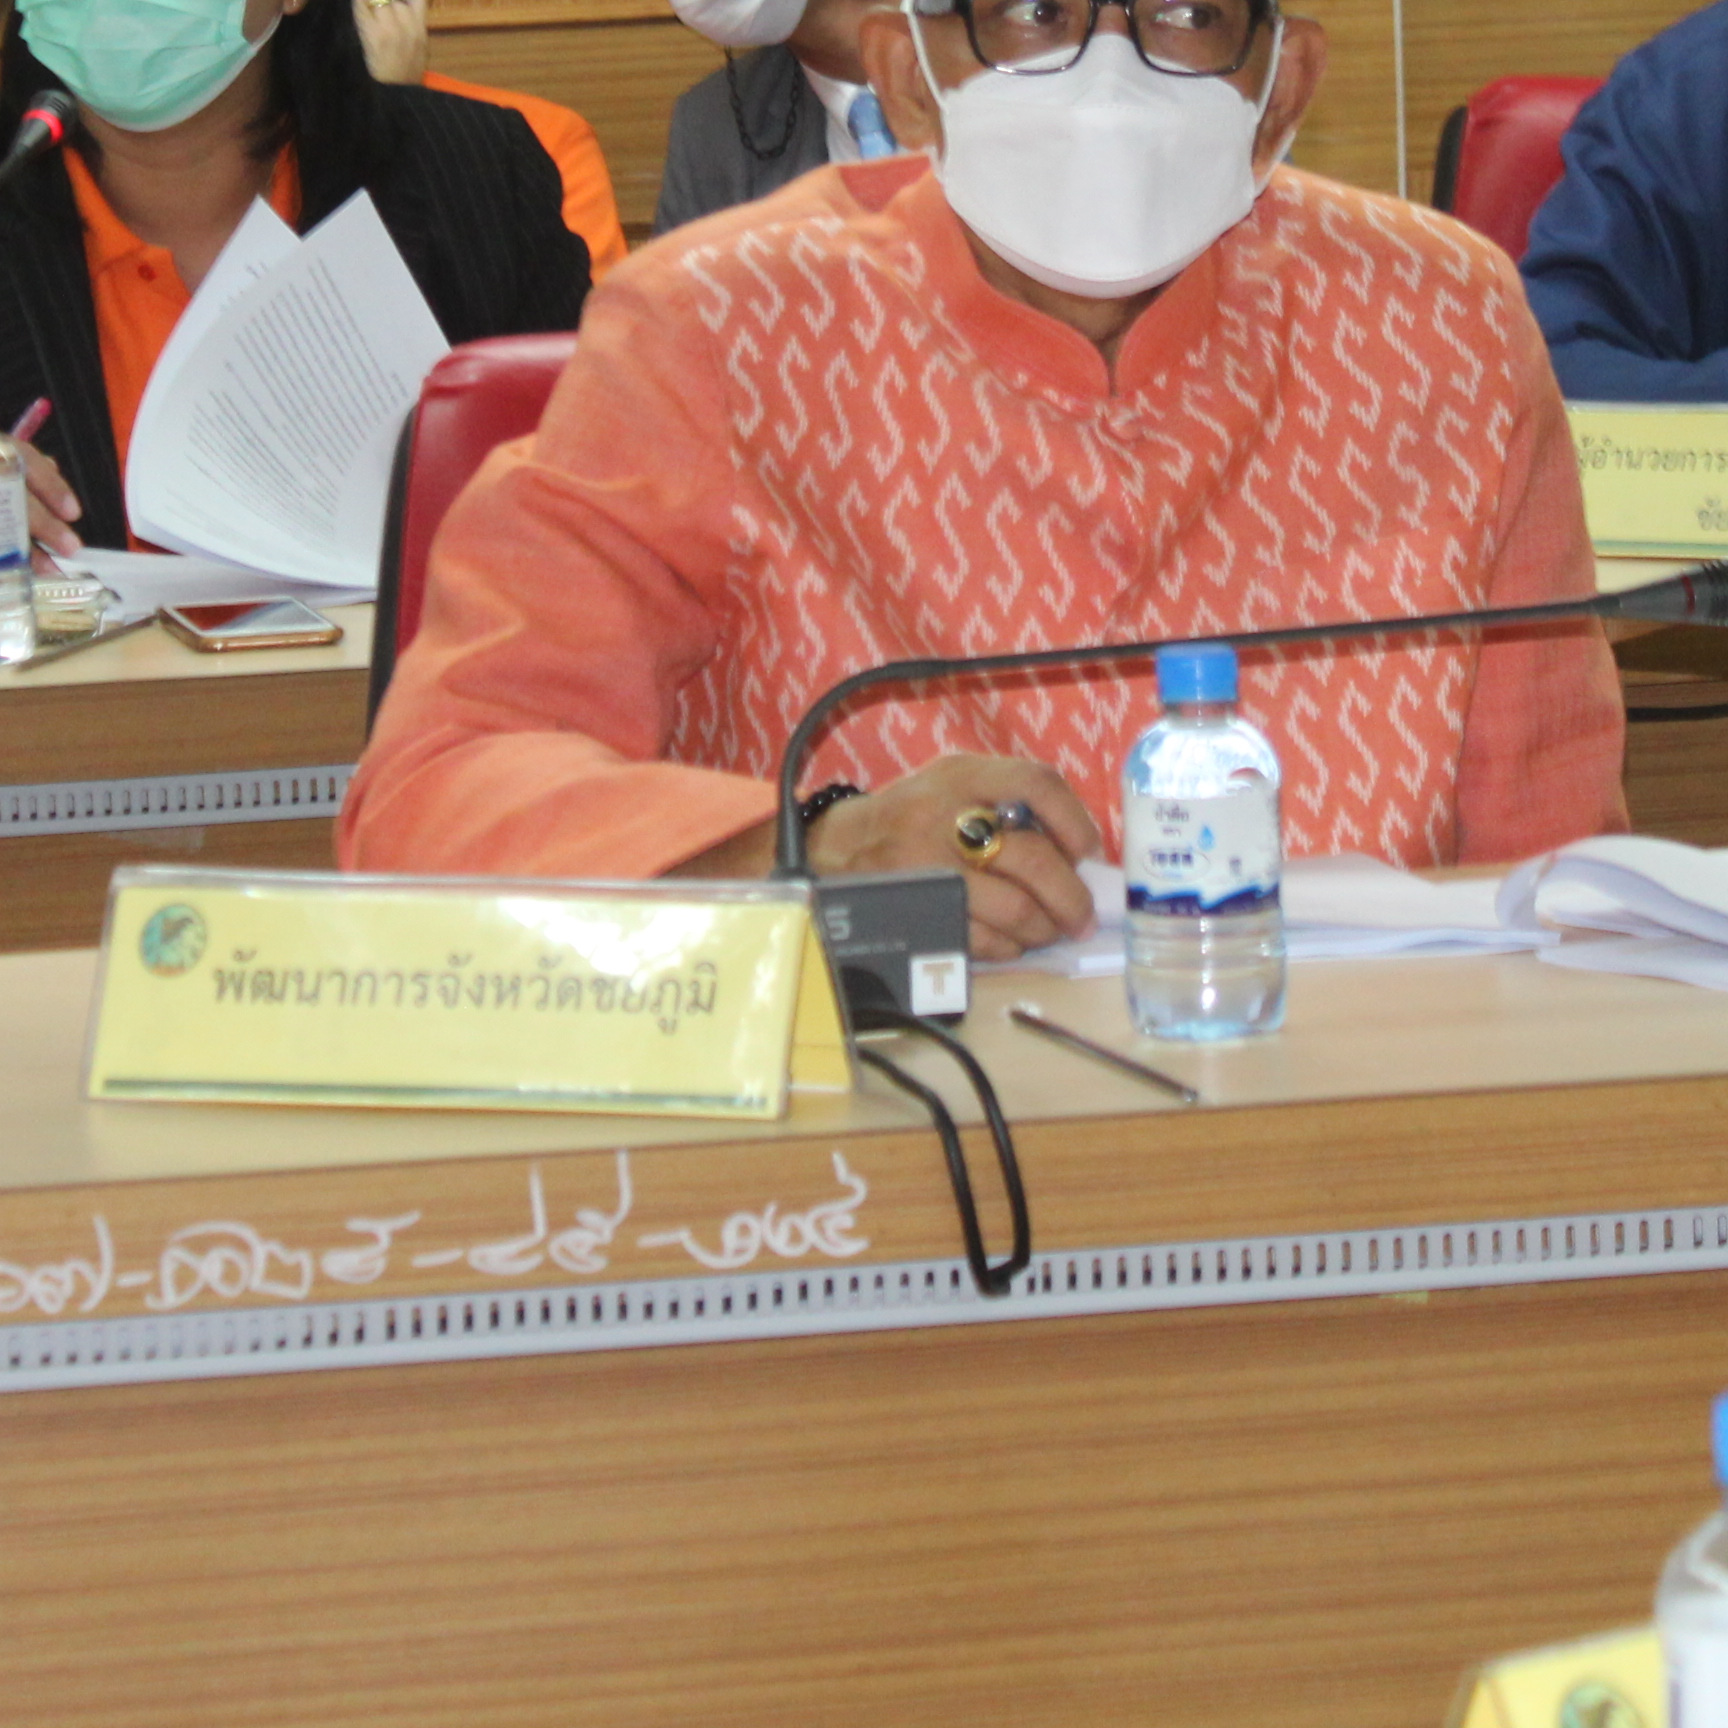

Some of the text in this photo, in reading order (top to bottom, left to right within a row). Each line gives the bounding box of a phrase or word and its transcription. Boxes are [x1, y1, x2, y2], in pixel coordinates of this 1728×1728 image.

[213, 948, 719, 1036] พัฒนาการจังหวัดชยภูมิ
